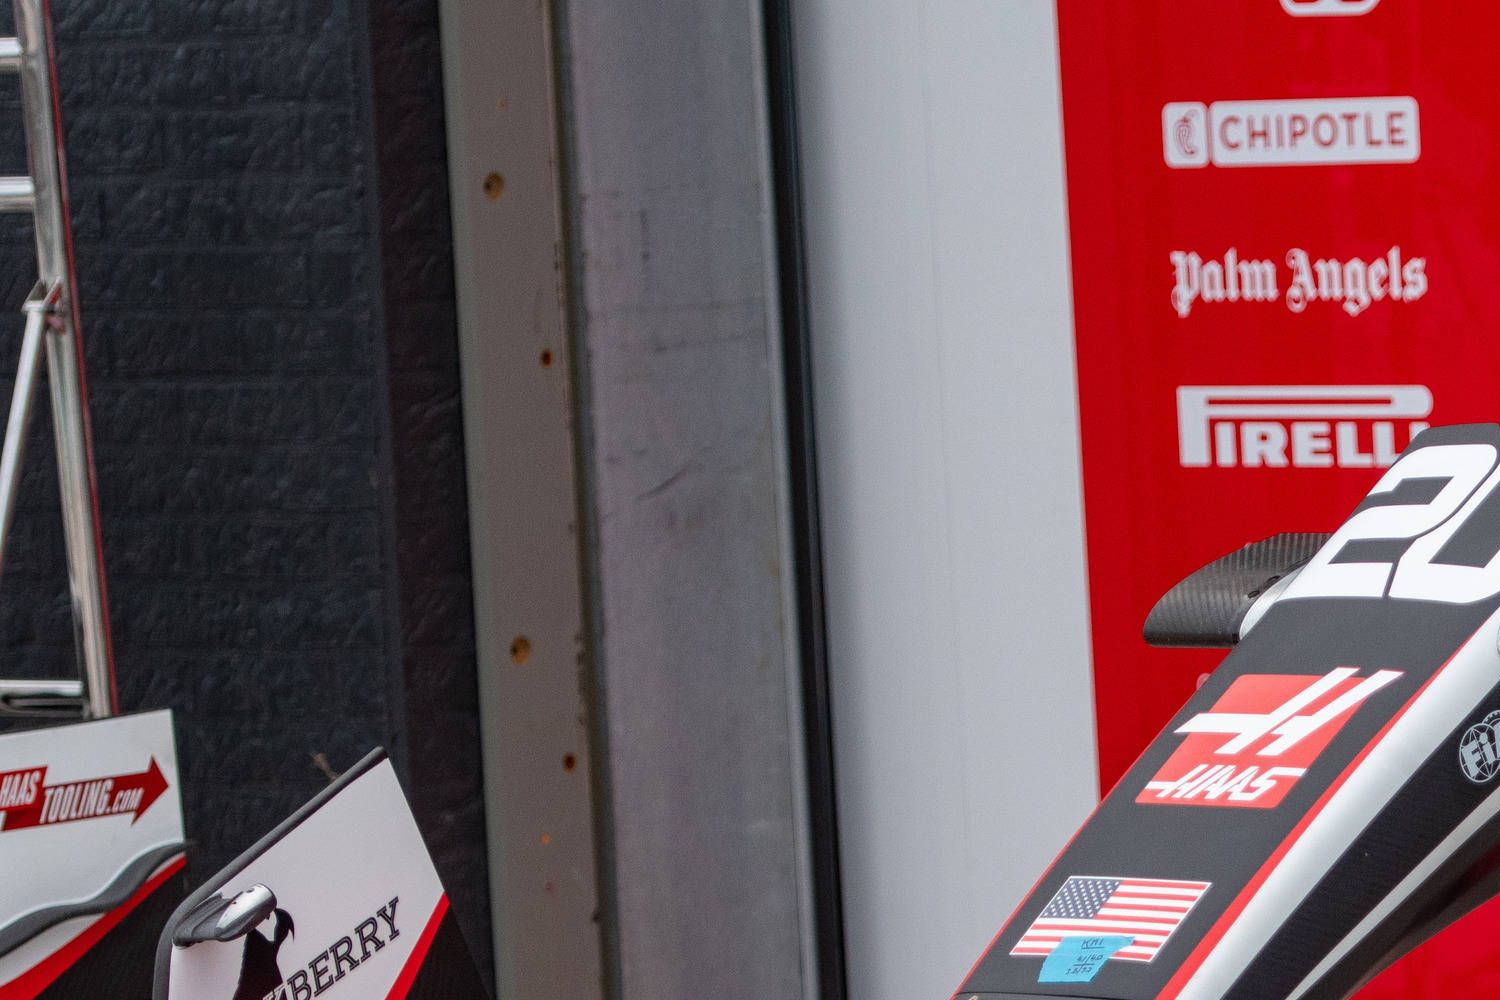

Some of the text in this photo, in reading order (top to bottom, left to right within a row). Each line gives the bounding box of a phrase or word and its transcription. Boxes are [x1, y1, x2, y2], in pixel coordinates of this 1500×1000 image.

[1218, 111, 1409, 150] CHIPOTLE
[1170, 245, 1429, 319] Palm Angels
[0, 770, 42, 808] HAAS
[1145, 764, 1308, 802] HAAS
